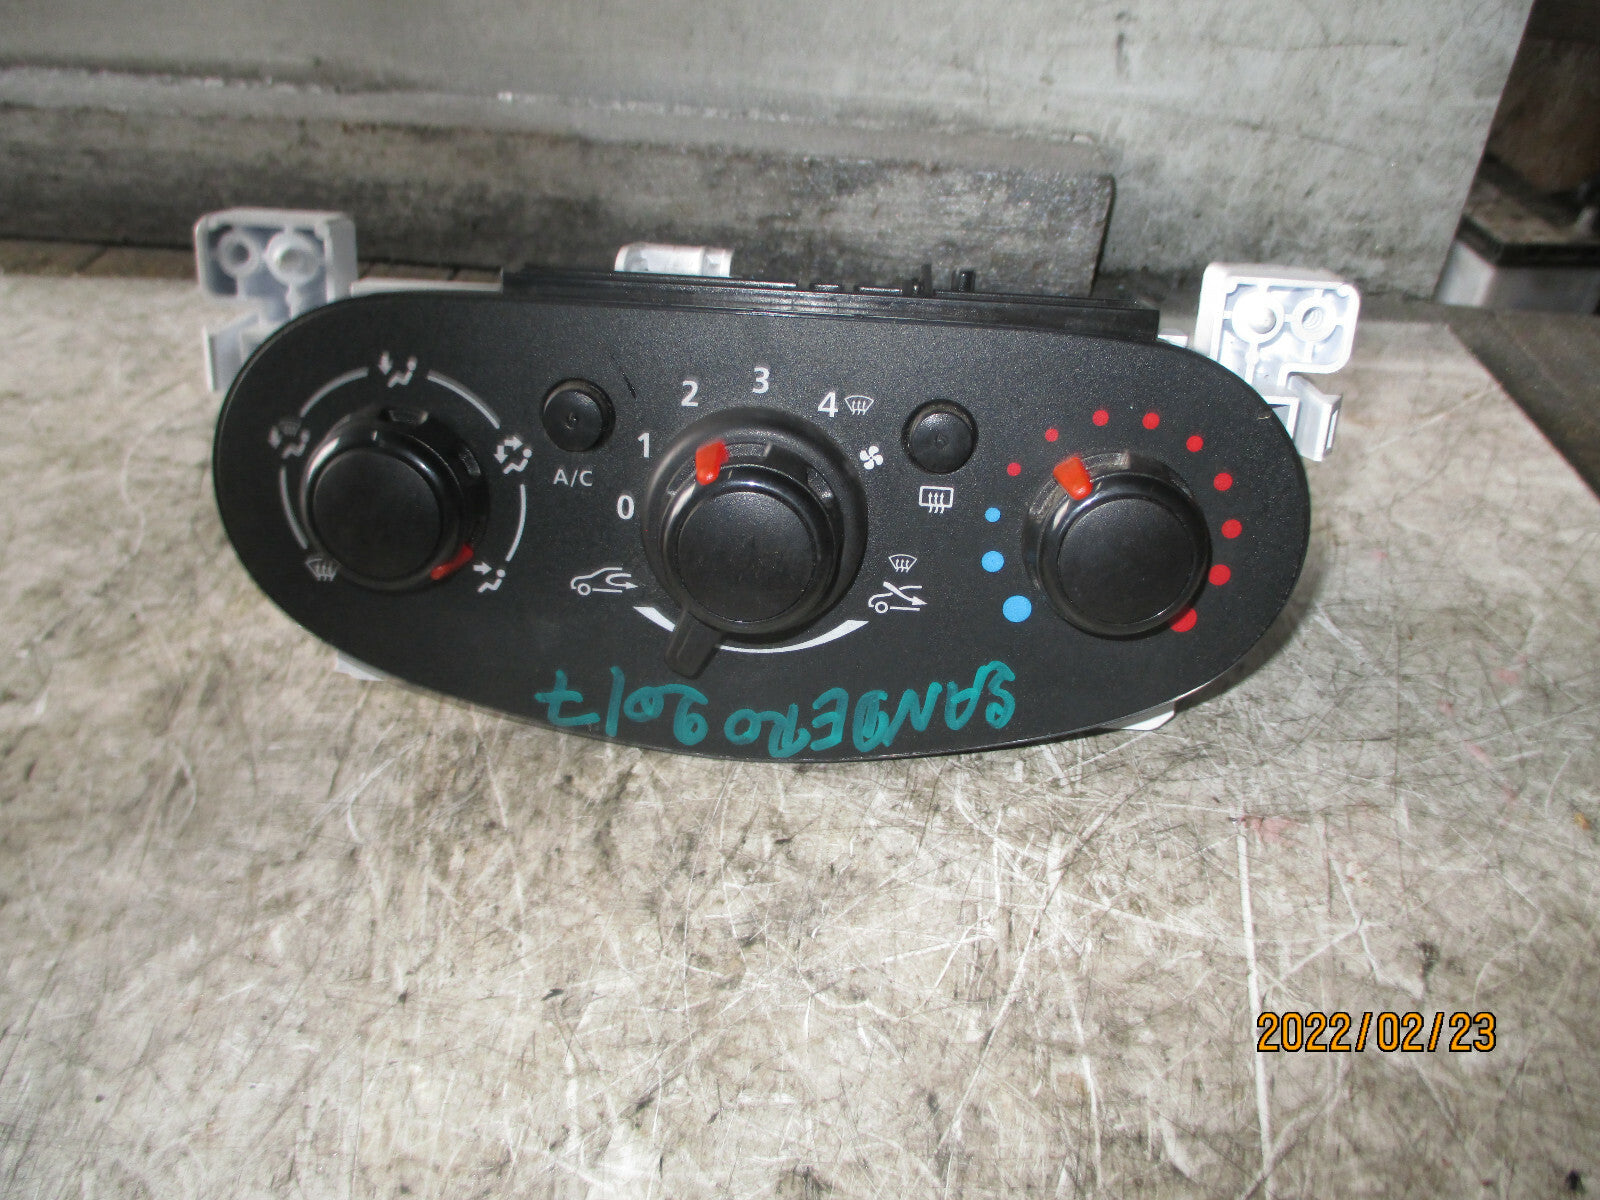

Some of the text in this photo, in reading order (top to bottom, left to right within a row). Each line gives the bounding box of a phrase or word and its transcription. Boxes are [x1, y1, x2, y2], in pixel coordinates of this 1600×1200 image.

[681, 380, 699, 407] 2
[753, 367, 770, 394] 3
[818, 391, 839, 418] 4
[637, 432, 650, 458] 1
[553, 468, 593, 487] A/C
[616, 494, 635, 520] 0
[535, 660, 1017, 758] SANDERO 2017
